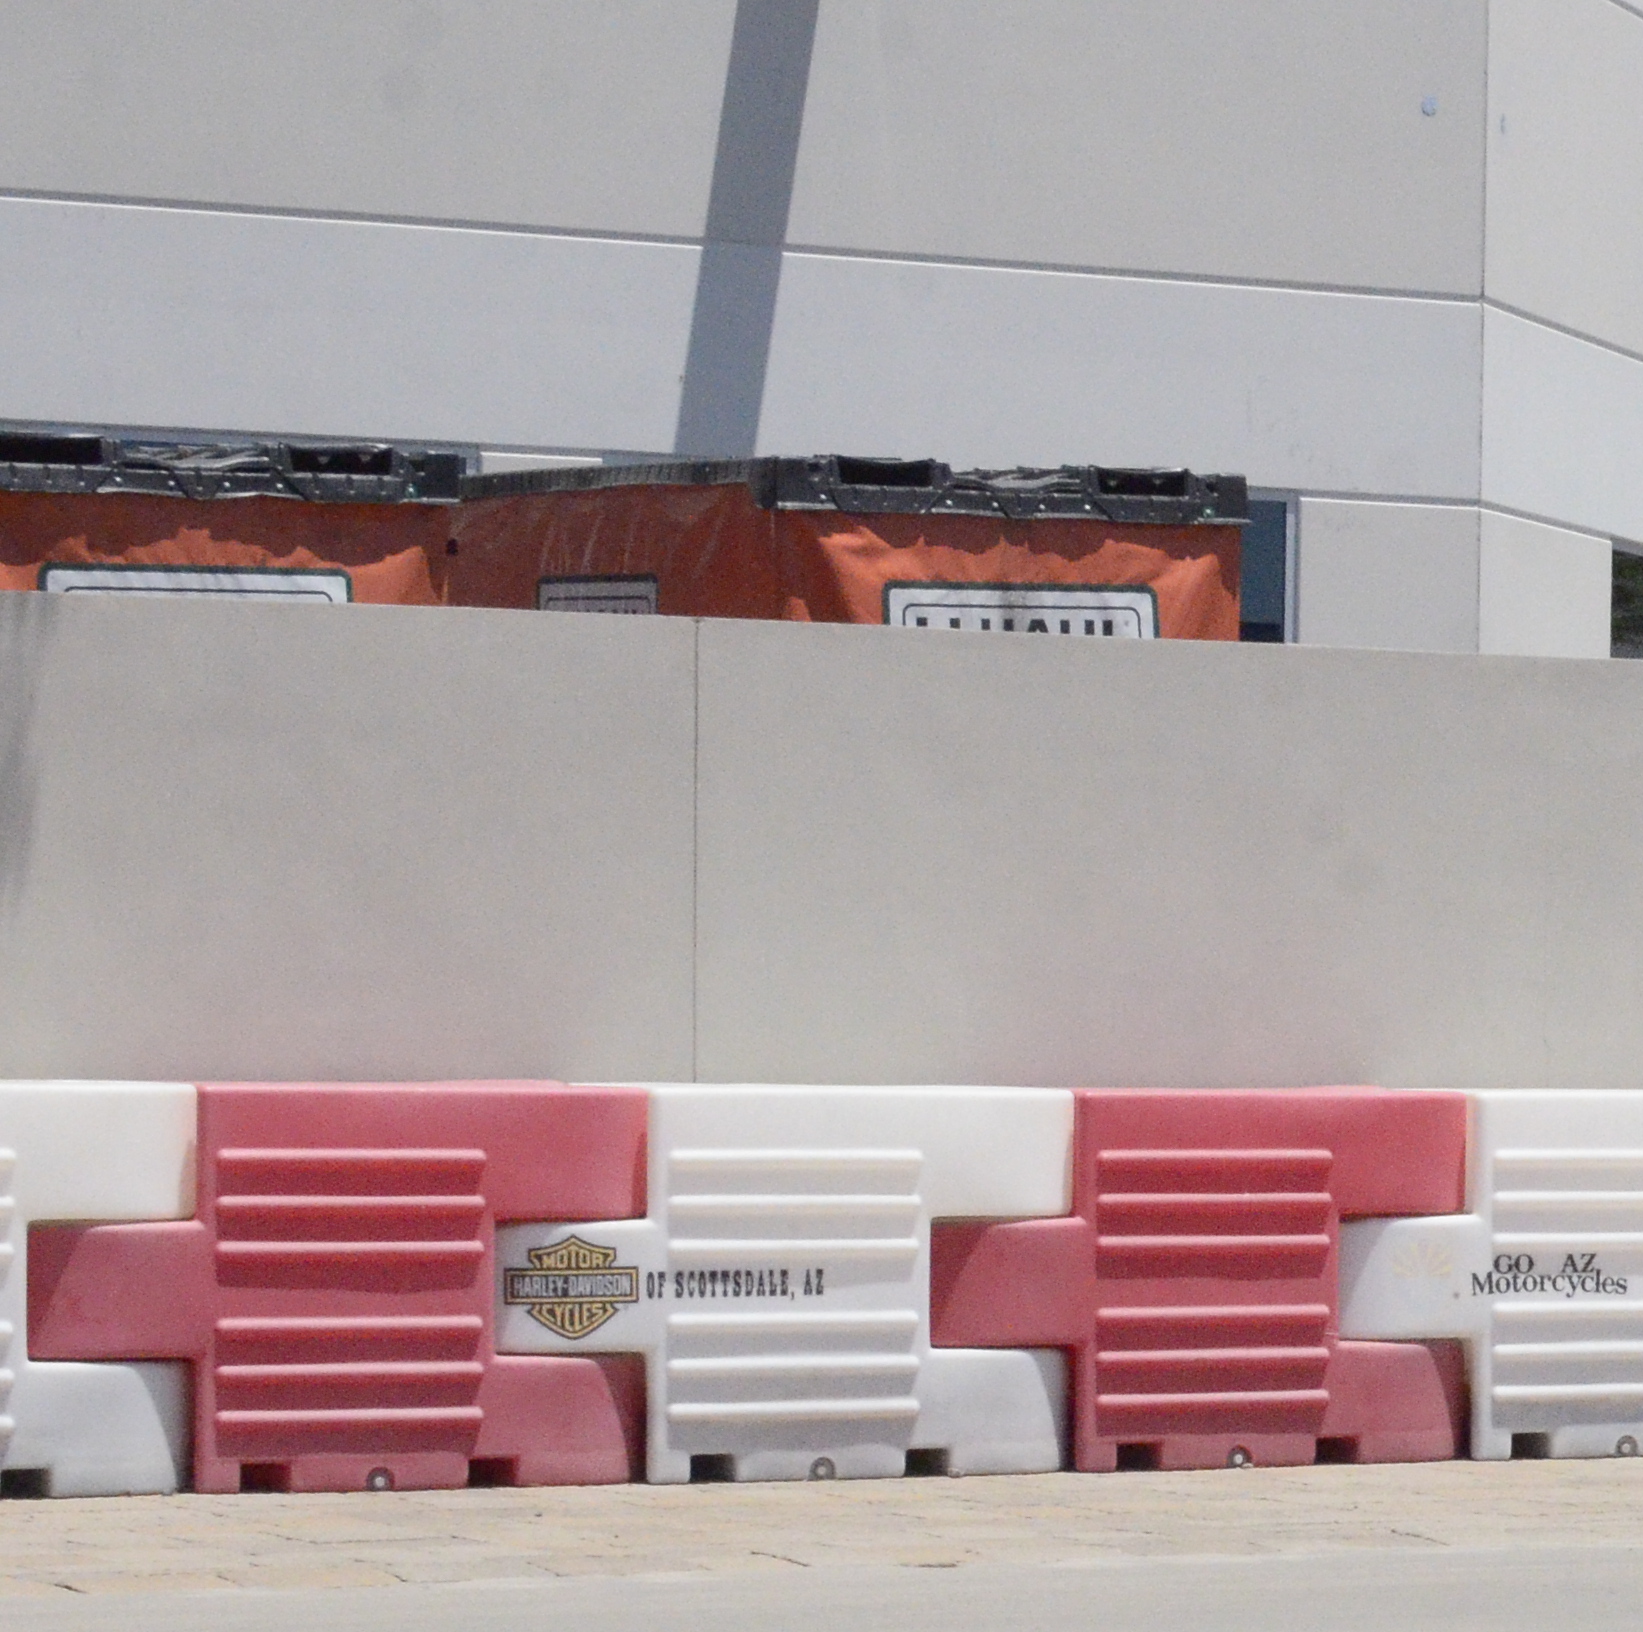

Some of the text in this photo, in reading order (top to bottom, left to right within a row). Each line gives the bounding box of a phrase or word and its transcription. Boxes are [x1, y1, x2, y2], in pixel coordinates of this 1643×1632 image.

[540, 1246, 606, 1269] MOTOR
[1493, 1253, 1597, 1274] GO AZ
[512, 1268, 825, 1301] HARLEY-DAVIDSON OF SCOTTSDALE, AZ
[1471, 1269, 1628, 1298] Motorcycles
[540, 1303, 605, 1333] CYCLES
